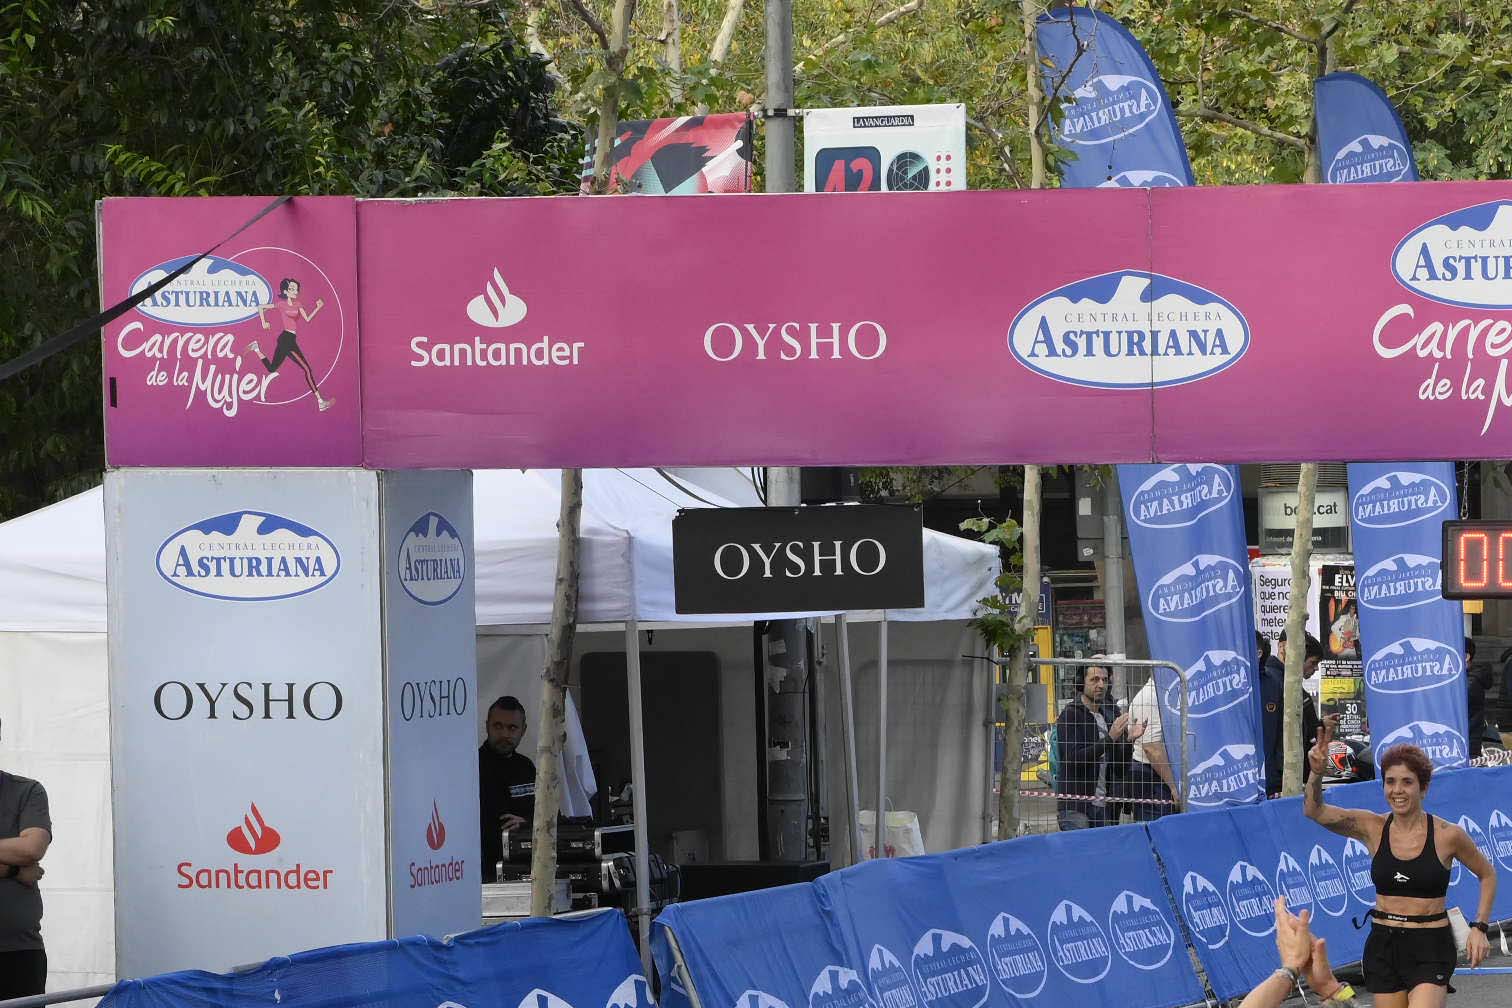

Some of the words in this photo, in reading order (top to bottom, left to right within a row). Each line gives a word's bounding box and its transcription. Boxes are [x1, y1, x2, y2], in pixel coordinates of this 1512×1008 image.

[169, 279, 207, 288] ENTRAL
[211, 279, 257, 287] LECHERA
[1064, 312, 1140, 323] CENTRAL
[1147, 311, 1223, 322] LECHERA
[117, 320, 235, 360] Carrera
[410, 335, 585, 367] Santander
[703, 321, 888, 362] OYSHO
[1026, 315, 1231, 358] ASTURIANA
[146, 361, 169, 387] de
[173, 360, 189, 388] la
[186, 354, 280, 418] Mujer
[1418, 362, 1453, 401] de
[1461, 361, 1485, 401] la
[1283, 501, 1338, 517] b.cat
[170, 543, 328, 579] ASTURIANA
[198, 542, 257, 552] CENTRAL
[262, 541, 321, 551] LECHERA
[713, 538, 888, 582] OYSHO
[404, 547, 462, 582] ASTURIANA
[1334, 574, 1356, 587] ELV
[1260, 591, 1276, 602] que
[152, 679, 343, 722] OYSHO
[400, 676, 468, 722] OYSHO
[1345, 703, 1358, 714] 30
[176, 861, 334, 890] Santander
[409, 857, 465, 889] Santander
[992, 947, 1045, 981] ASTURIANA
[1054, 934, 1109, 966] ASTURIANA
[917, 963, 987, 1002] ASTURIANA
